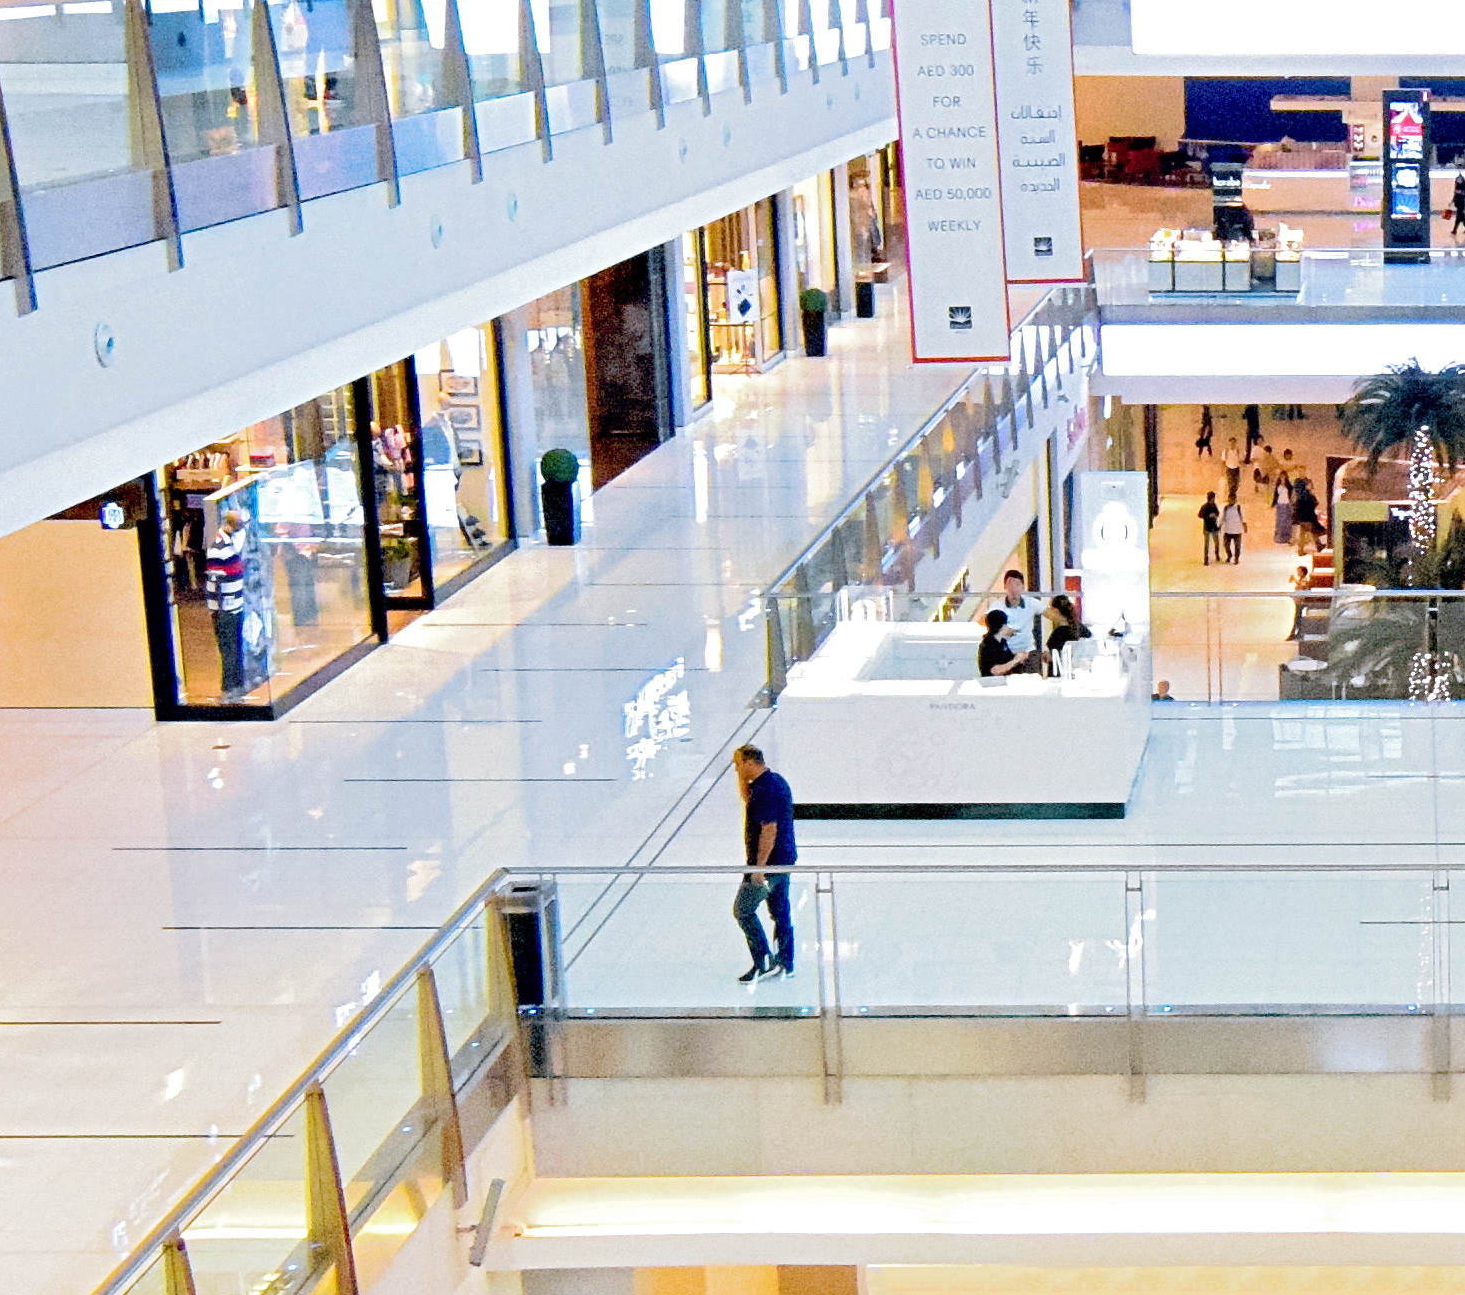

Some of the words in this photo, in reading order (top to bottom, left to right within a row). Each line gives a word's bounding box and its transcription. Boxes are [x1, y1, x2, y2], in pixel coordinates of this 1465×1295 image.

[920, 33, 967, 46] SPEND
[917, 65, 945, 77] AED
[950, 64, 974, 76] 300
[933, 95, 961, 108] FOR
[913, 127, 927, 139] A
[931, 126, 987, 139] CHANCE
[927, 158, 946, 170] TO
[950, 157, 976, 169] WIN
[915, 189, 943, 201] AED
[947, 187, 992, 202] 50,000
[927, 219, 982, 233] WEEKLY
